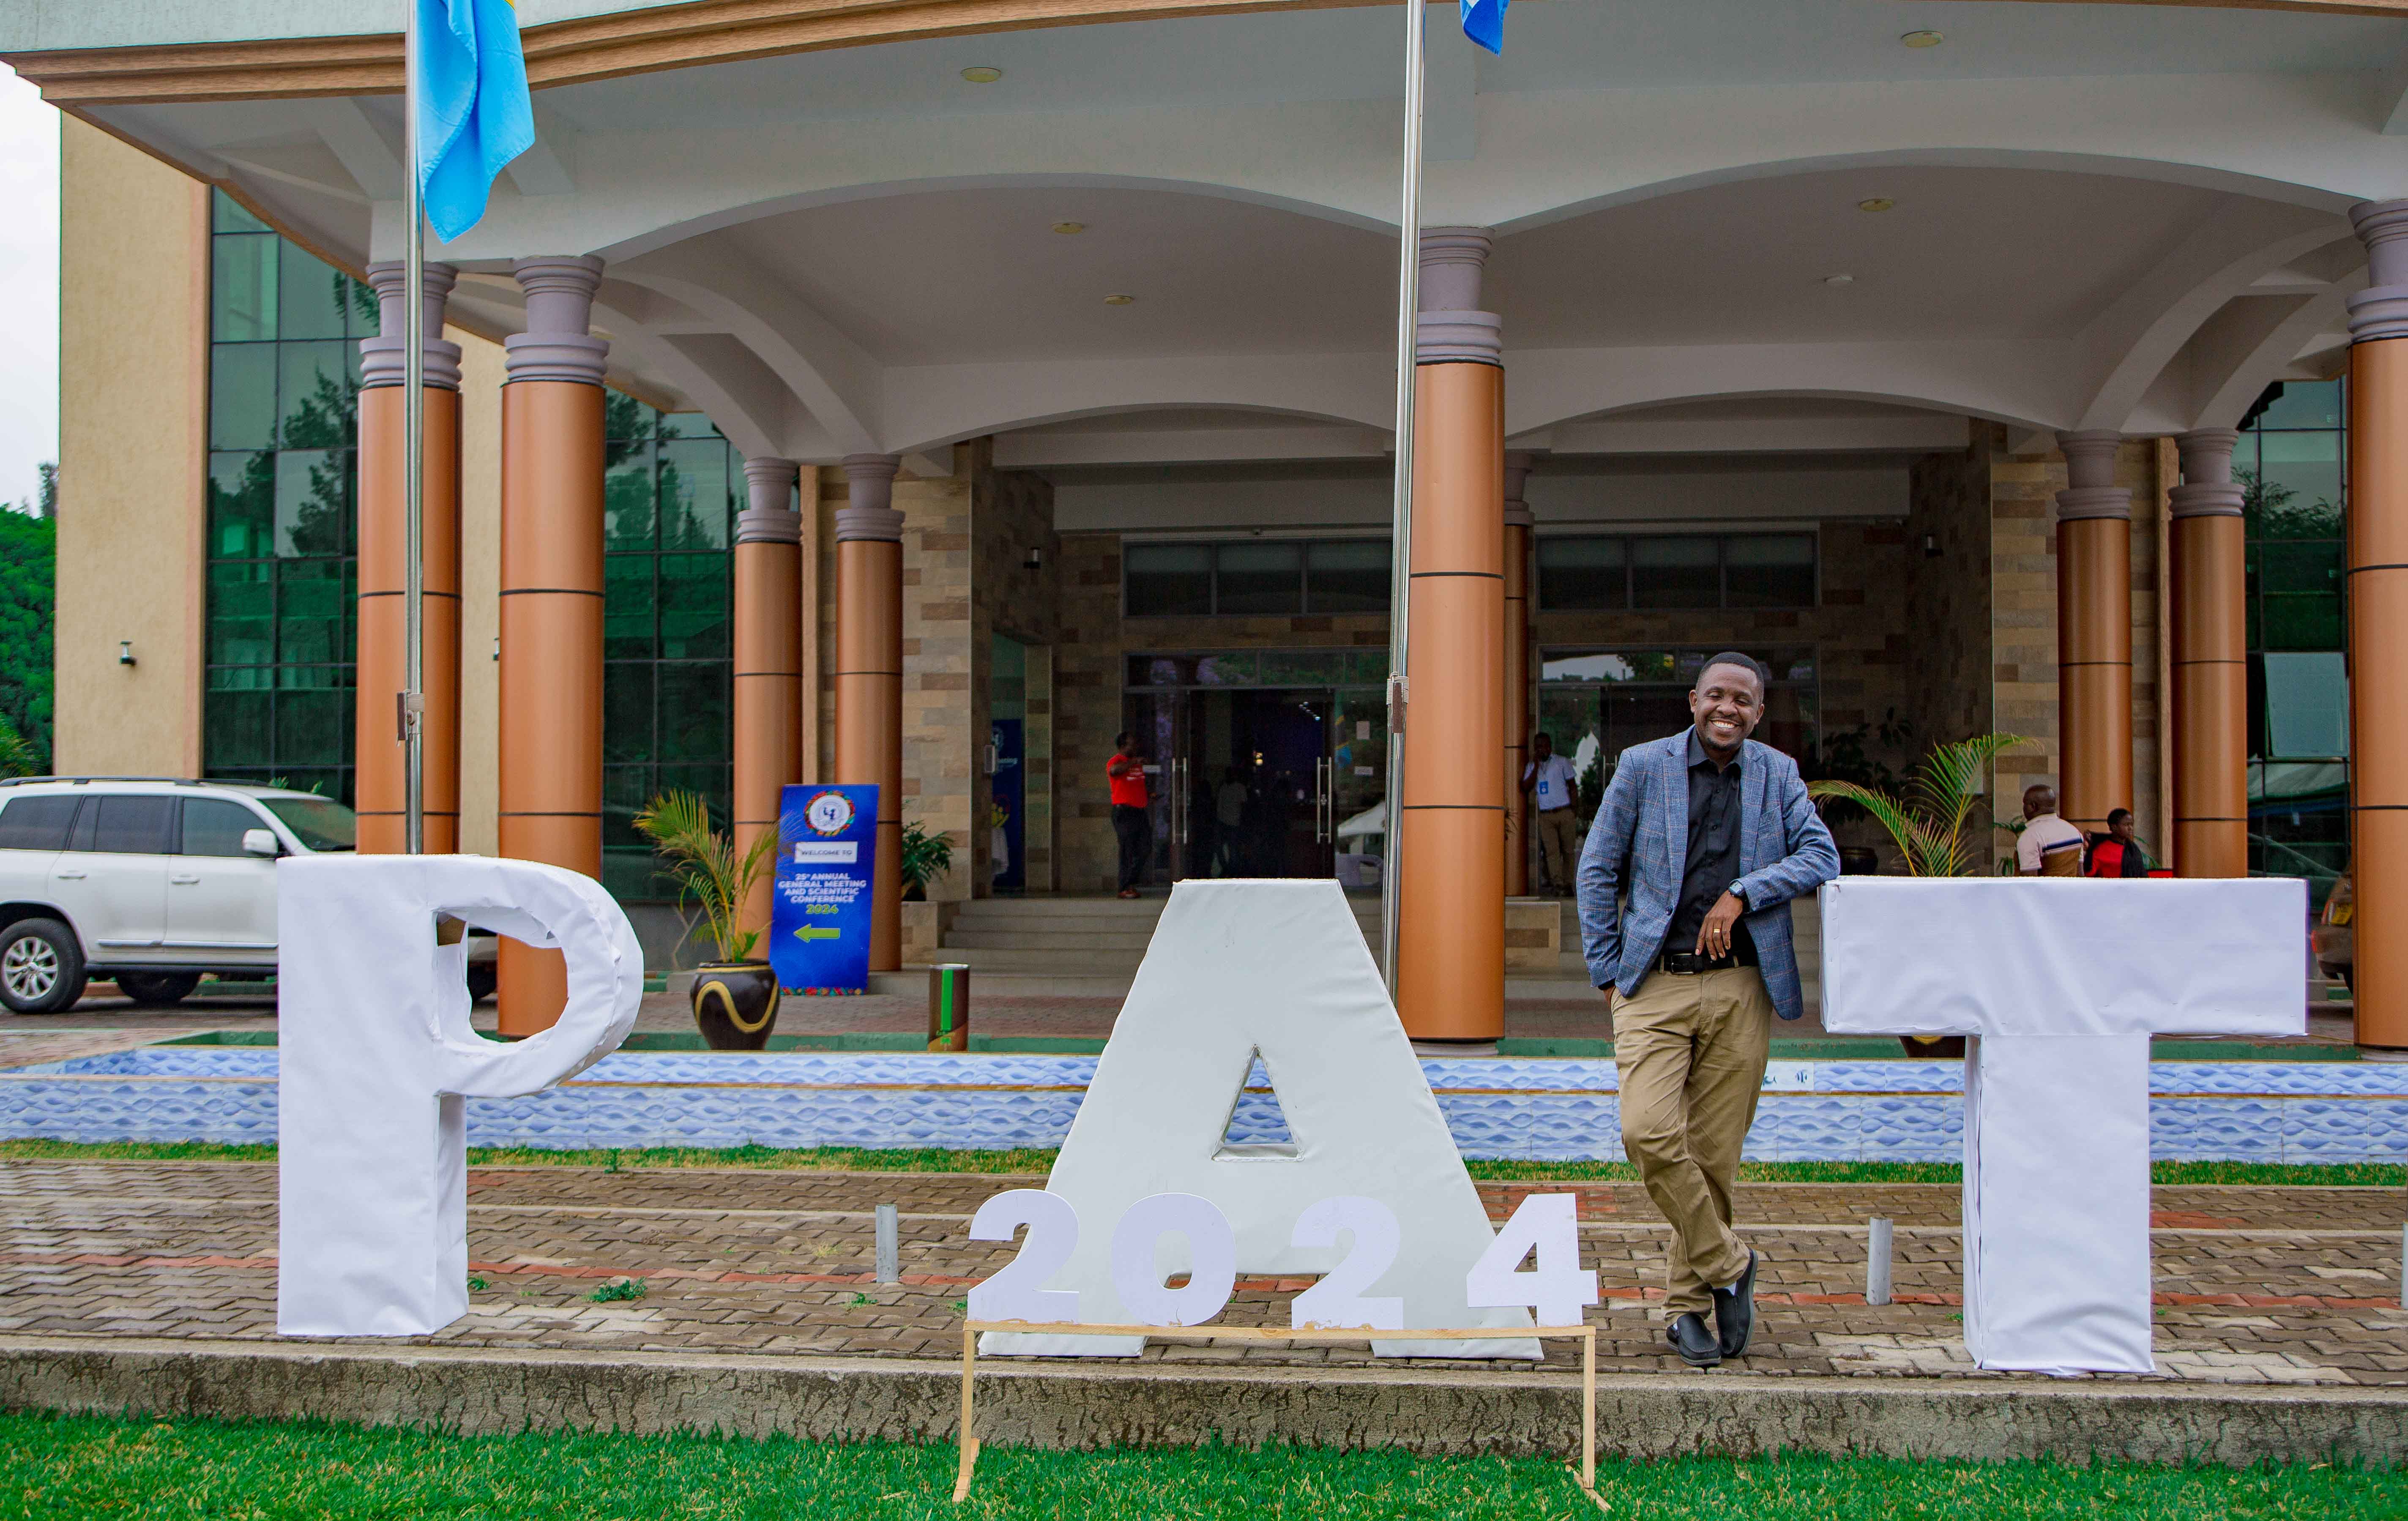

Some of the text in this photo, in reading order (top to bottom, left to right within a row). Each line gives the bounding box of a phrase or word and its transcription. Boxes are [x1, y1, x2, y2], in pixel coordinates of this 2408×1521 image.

[810, 872, 850, 880] ANNUAL
[823, 880, 866, 888] MEETING
[806, 904, 839, 914] 2024
[277, 854, 644, 1336] P
[1817, 875, 2308, 1377] T
[967, 1188, 1599, 1331] 2024
